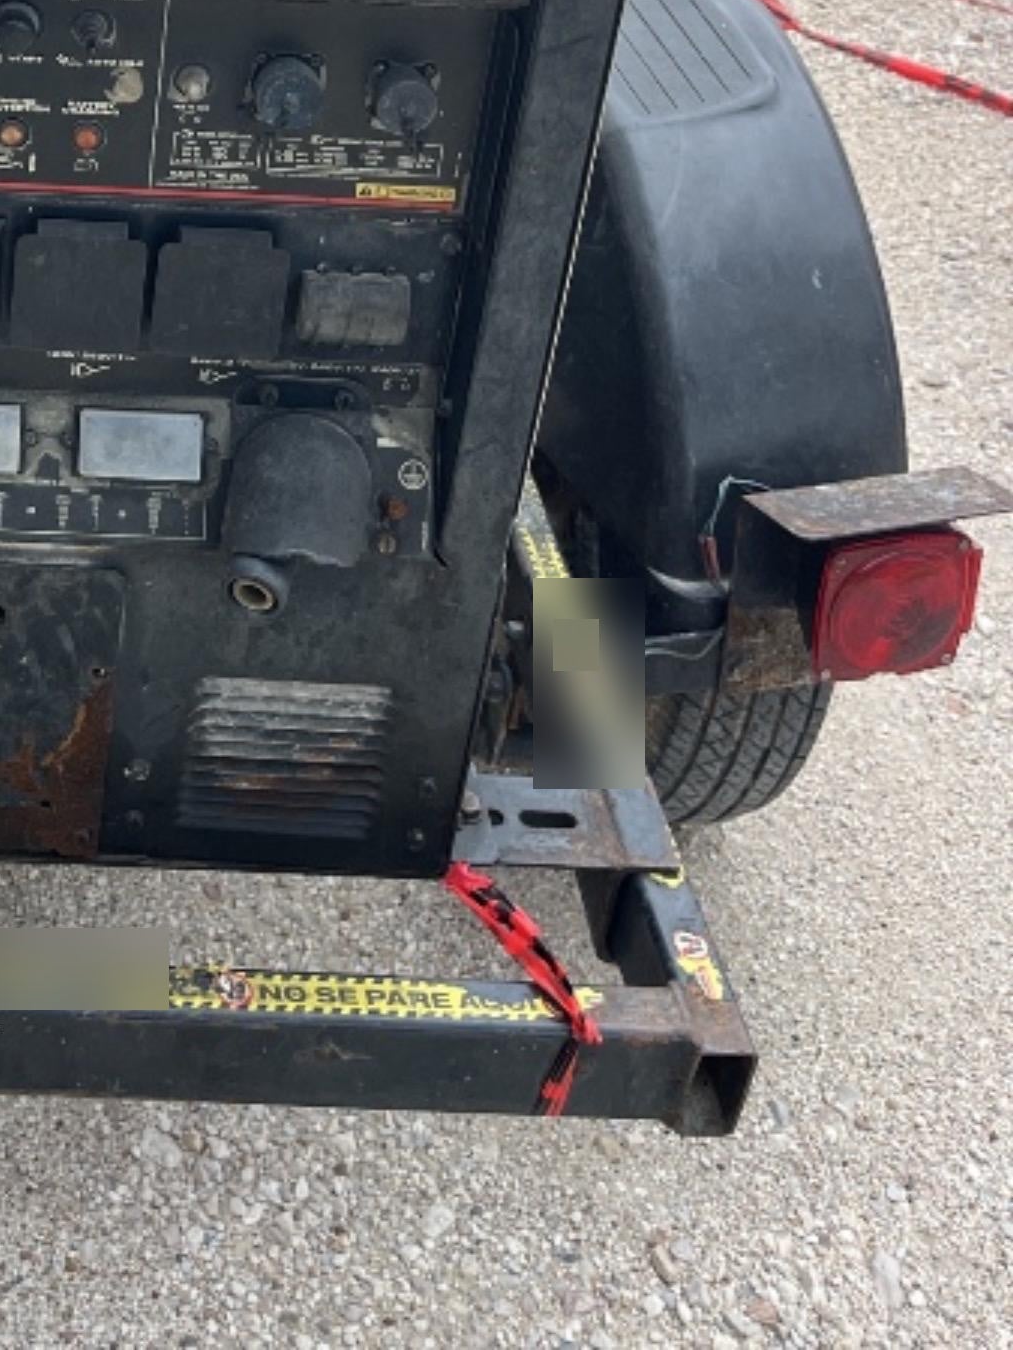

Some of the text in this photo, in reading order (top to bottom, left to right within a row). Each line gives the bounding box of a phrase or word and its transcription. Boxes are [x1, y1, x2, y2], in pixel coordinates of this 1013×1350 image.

[259, 984, 306, 1003] NO
[314, 987, 357, 1006] SE
[364, 989, 454, 1010] PARE
